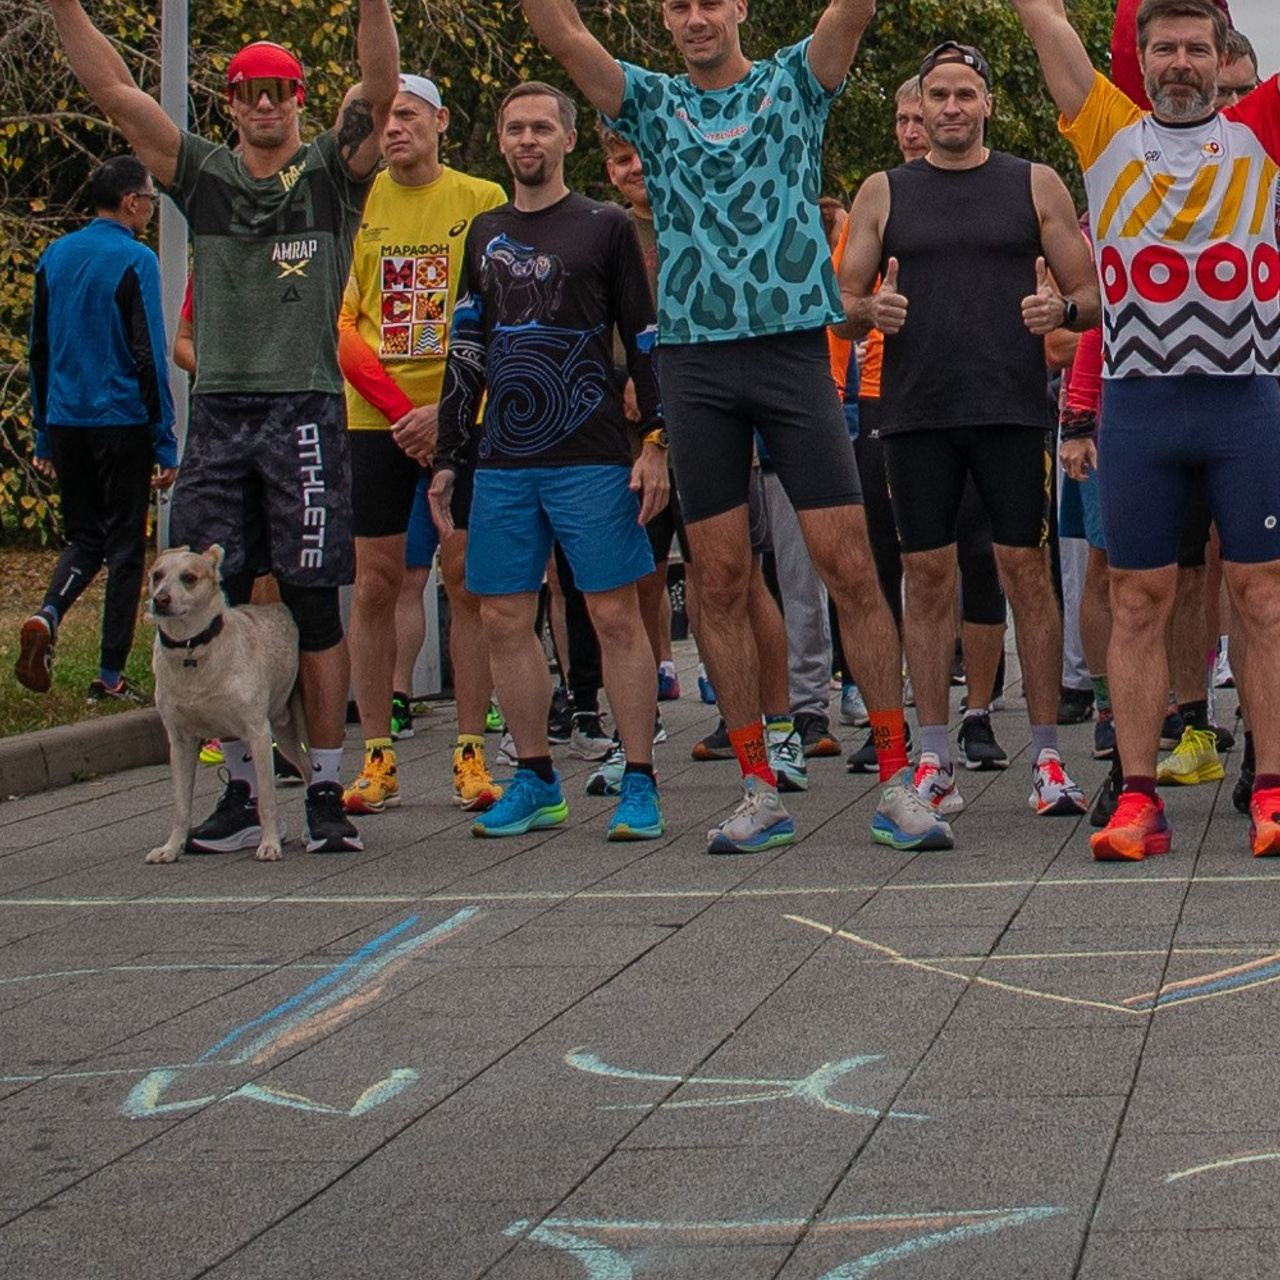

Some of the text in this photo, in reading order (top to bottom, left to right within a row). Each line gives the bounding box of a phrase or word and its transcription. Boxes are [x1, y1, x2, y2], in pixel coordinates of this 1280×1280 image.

[272, 239, 318, 261] AMRAP
[381, 244, 449, 257] МАРАФОН
[297, 423, 326, 568] ATHLETE
